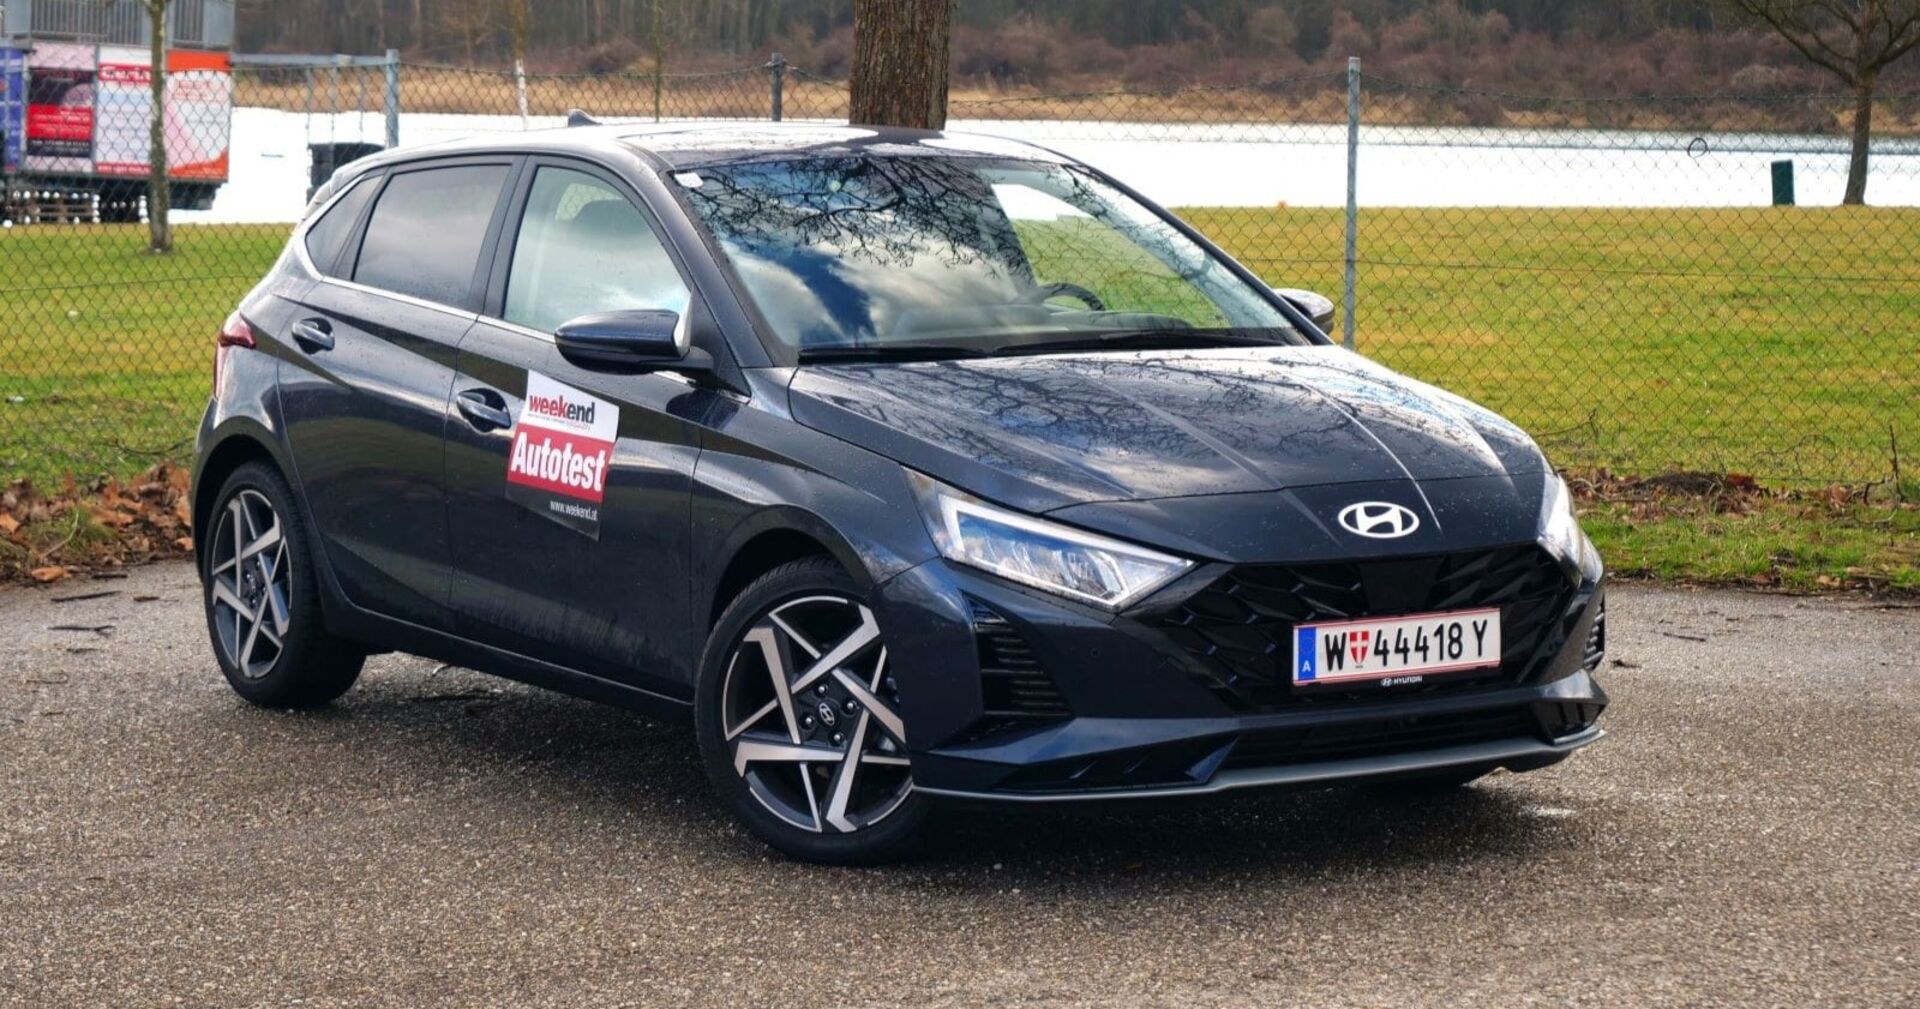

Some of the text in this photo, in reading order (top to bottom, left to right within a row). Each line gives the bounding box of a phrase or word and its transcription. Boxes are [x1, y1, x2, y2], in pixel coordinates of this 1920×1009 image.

[529, 395, 595, 424] weekend
[510, 432, 606, 492] Autotest
[550, 501, 598, 521] www.weekend.at
[1324, 619, 1488, 672] W 44418 Y
[1302, 660, 1312, 673] A
[1393, 675, 1423, 685] HYUNDAI
